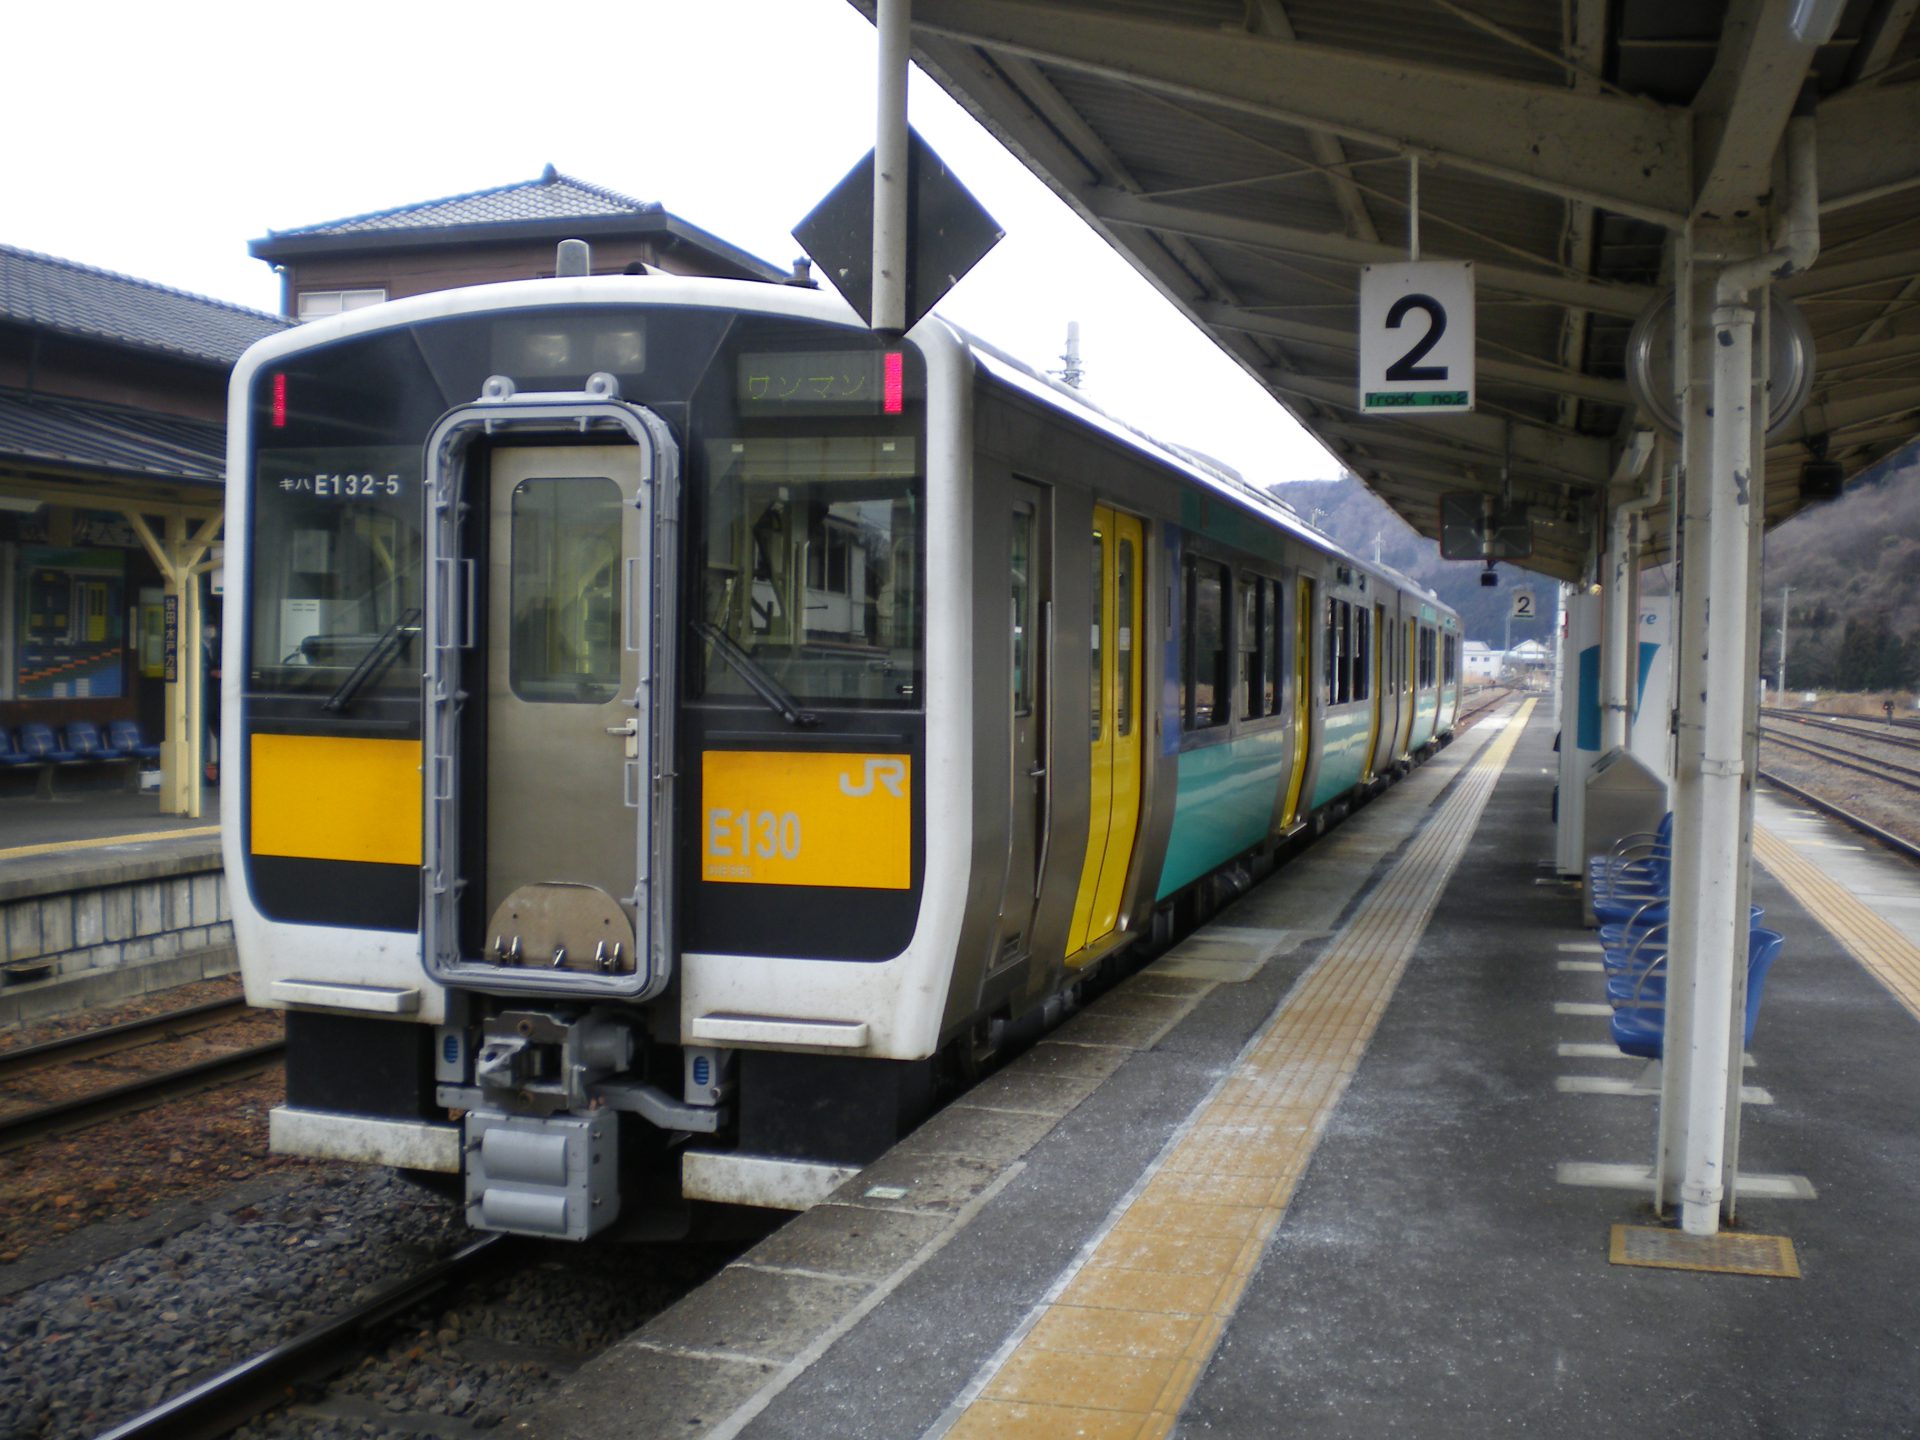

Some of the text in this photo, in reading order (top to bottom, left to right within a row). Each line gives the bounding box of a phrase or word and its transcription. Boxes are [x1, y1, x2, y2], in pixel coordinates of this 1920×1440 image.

[1386, 293, 1448, 381] 2
[749, 375, 865, 399] ワンマン
[279, 474, 399, 495] キハ E132-5
[1517, 596, 1531, 614] 2
[839, 759, 906, 797] JR
[708, 808, 801, 860] E130
